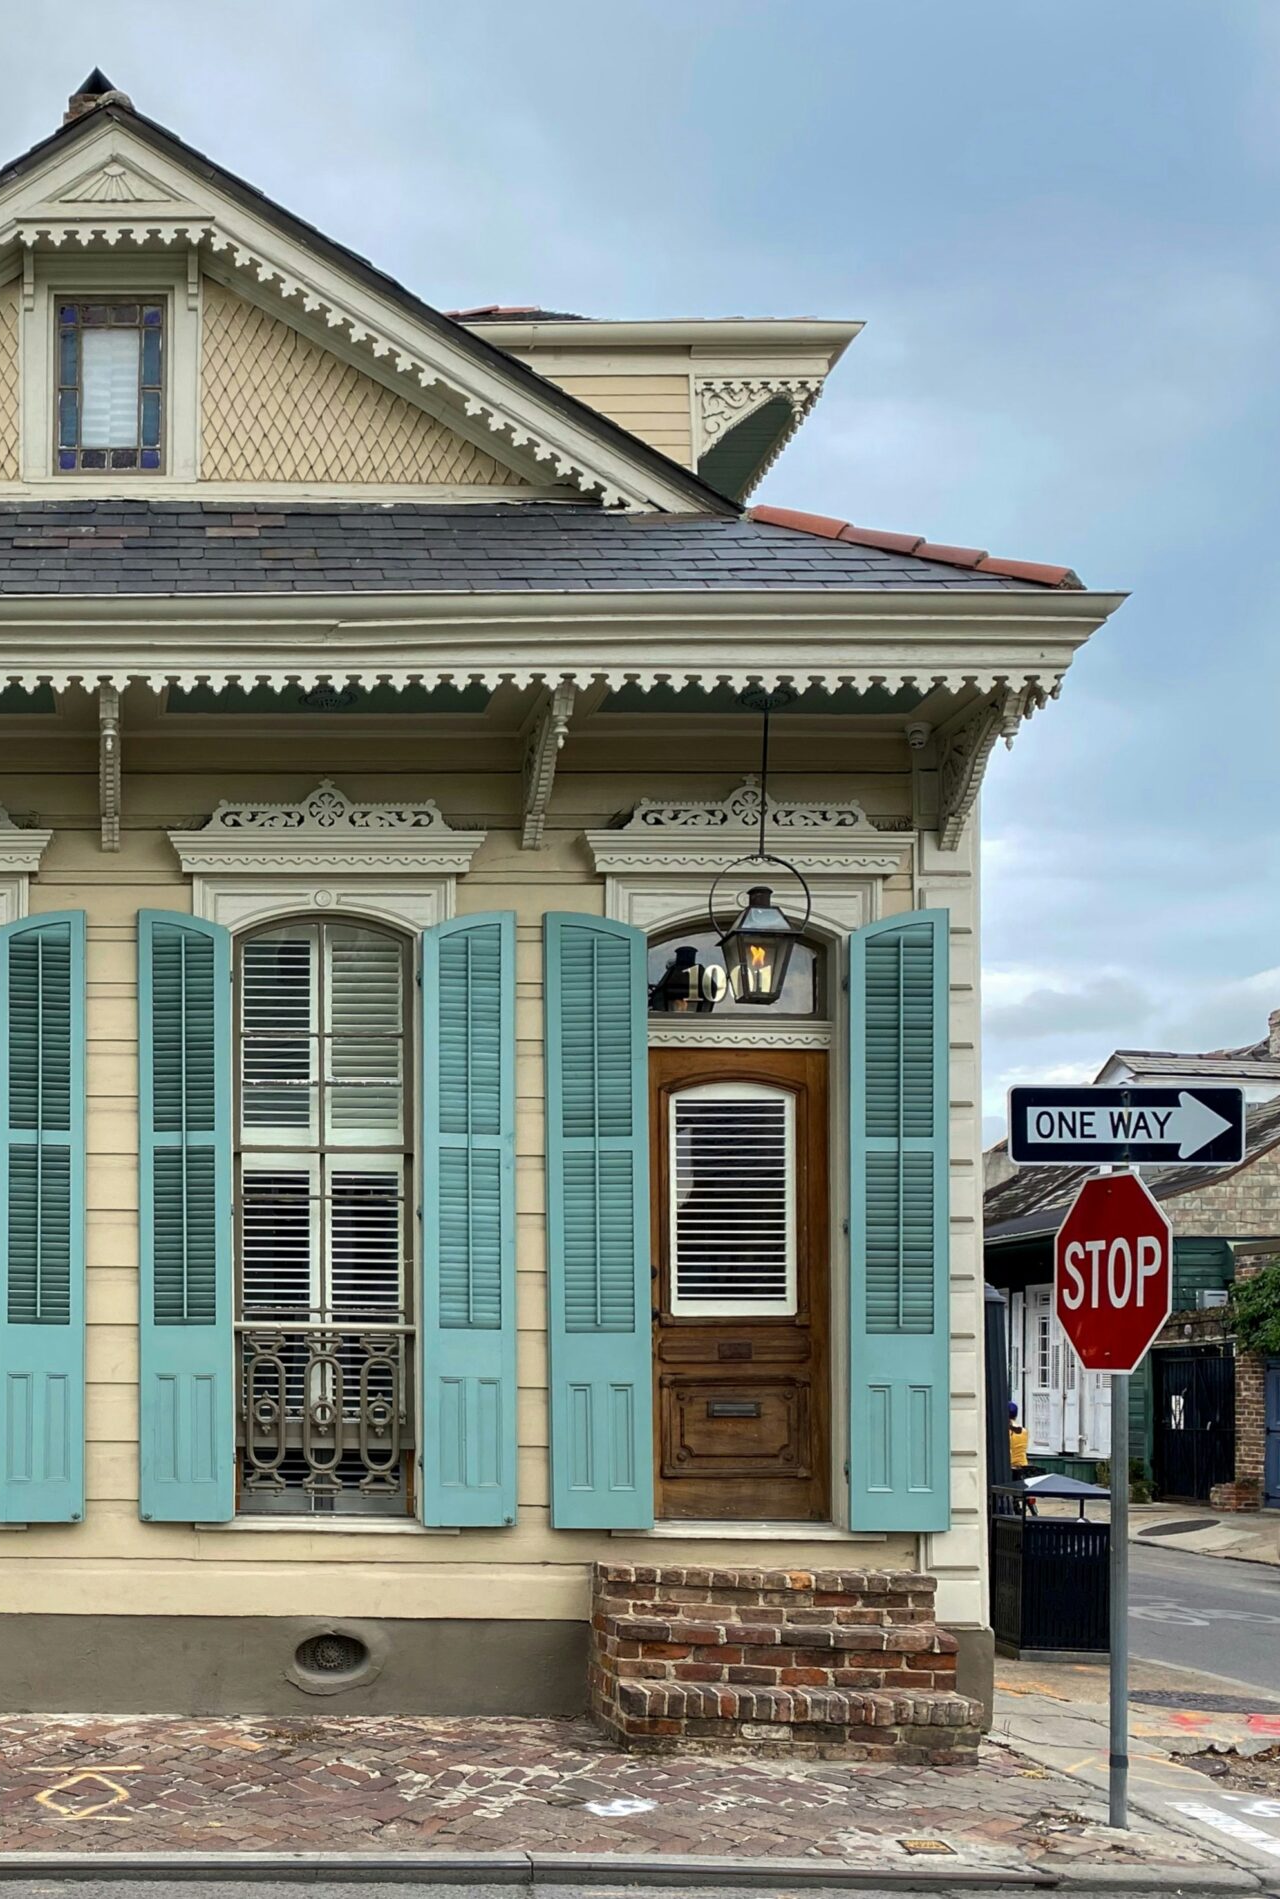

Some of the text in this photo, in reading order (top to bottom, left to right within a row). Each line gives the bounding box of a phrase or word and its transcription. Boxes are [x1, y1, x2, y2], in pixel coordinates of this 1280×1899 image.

[1035, 1111, 1173, 1139] ONE WAY
[1062, 1236, 1162, 1310] STOP
